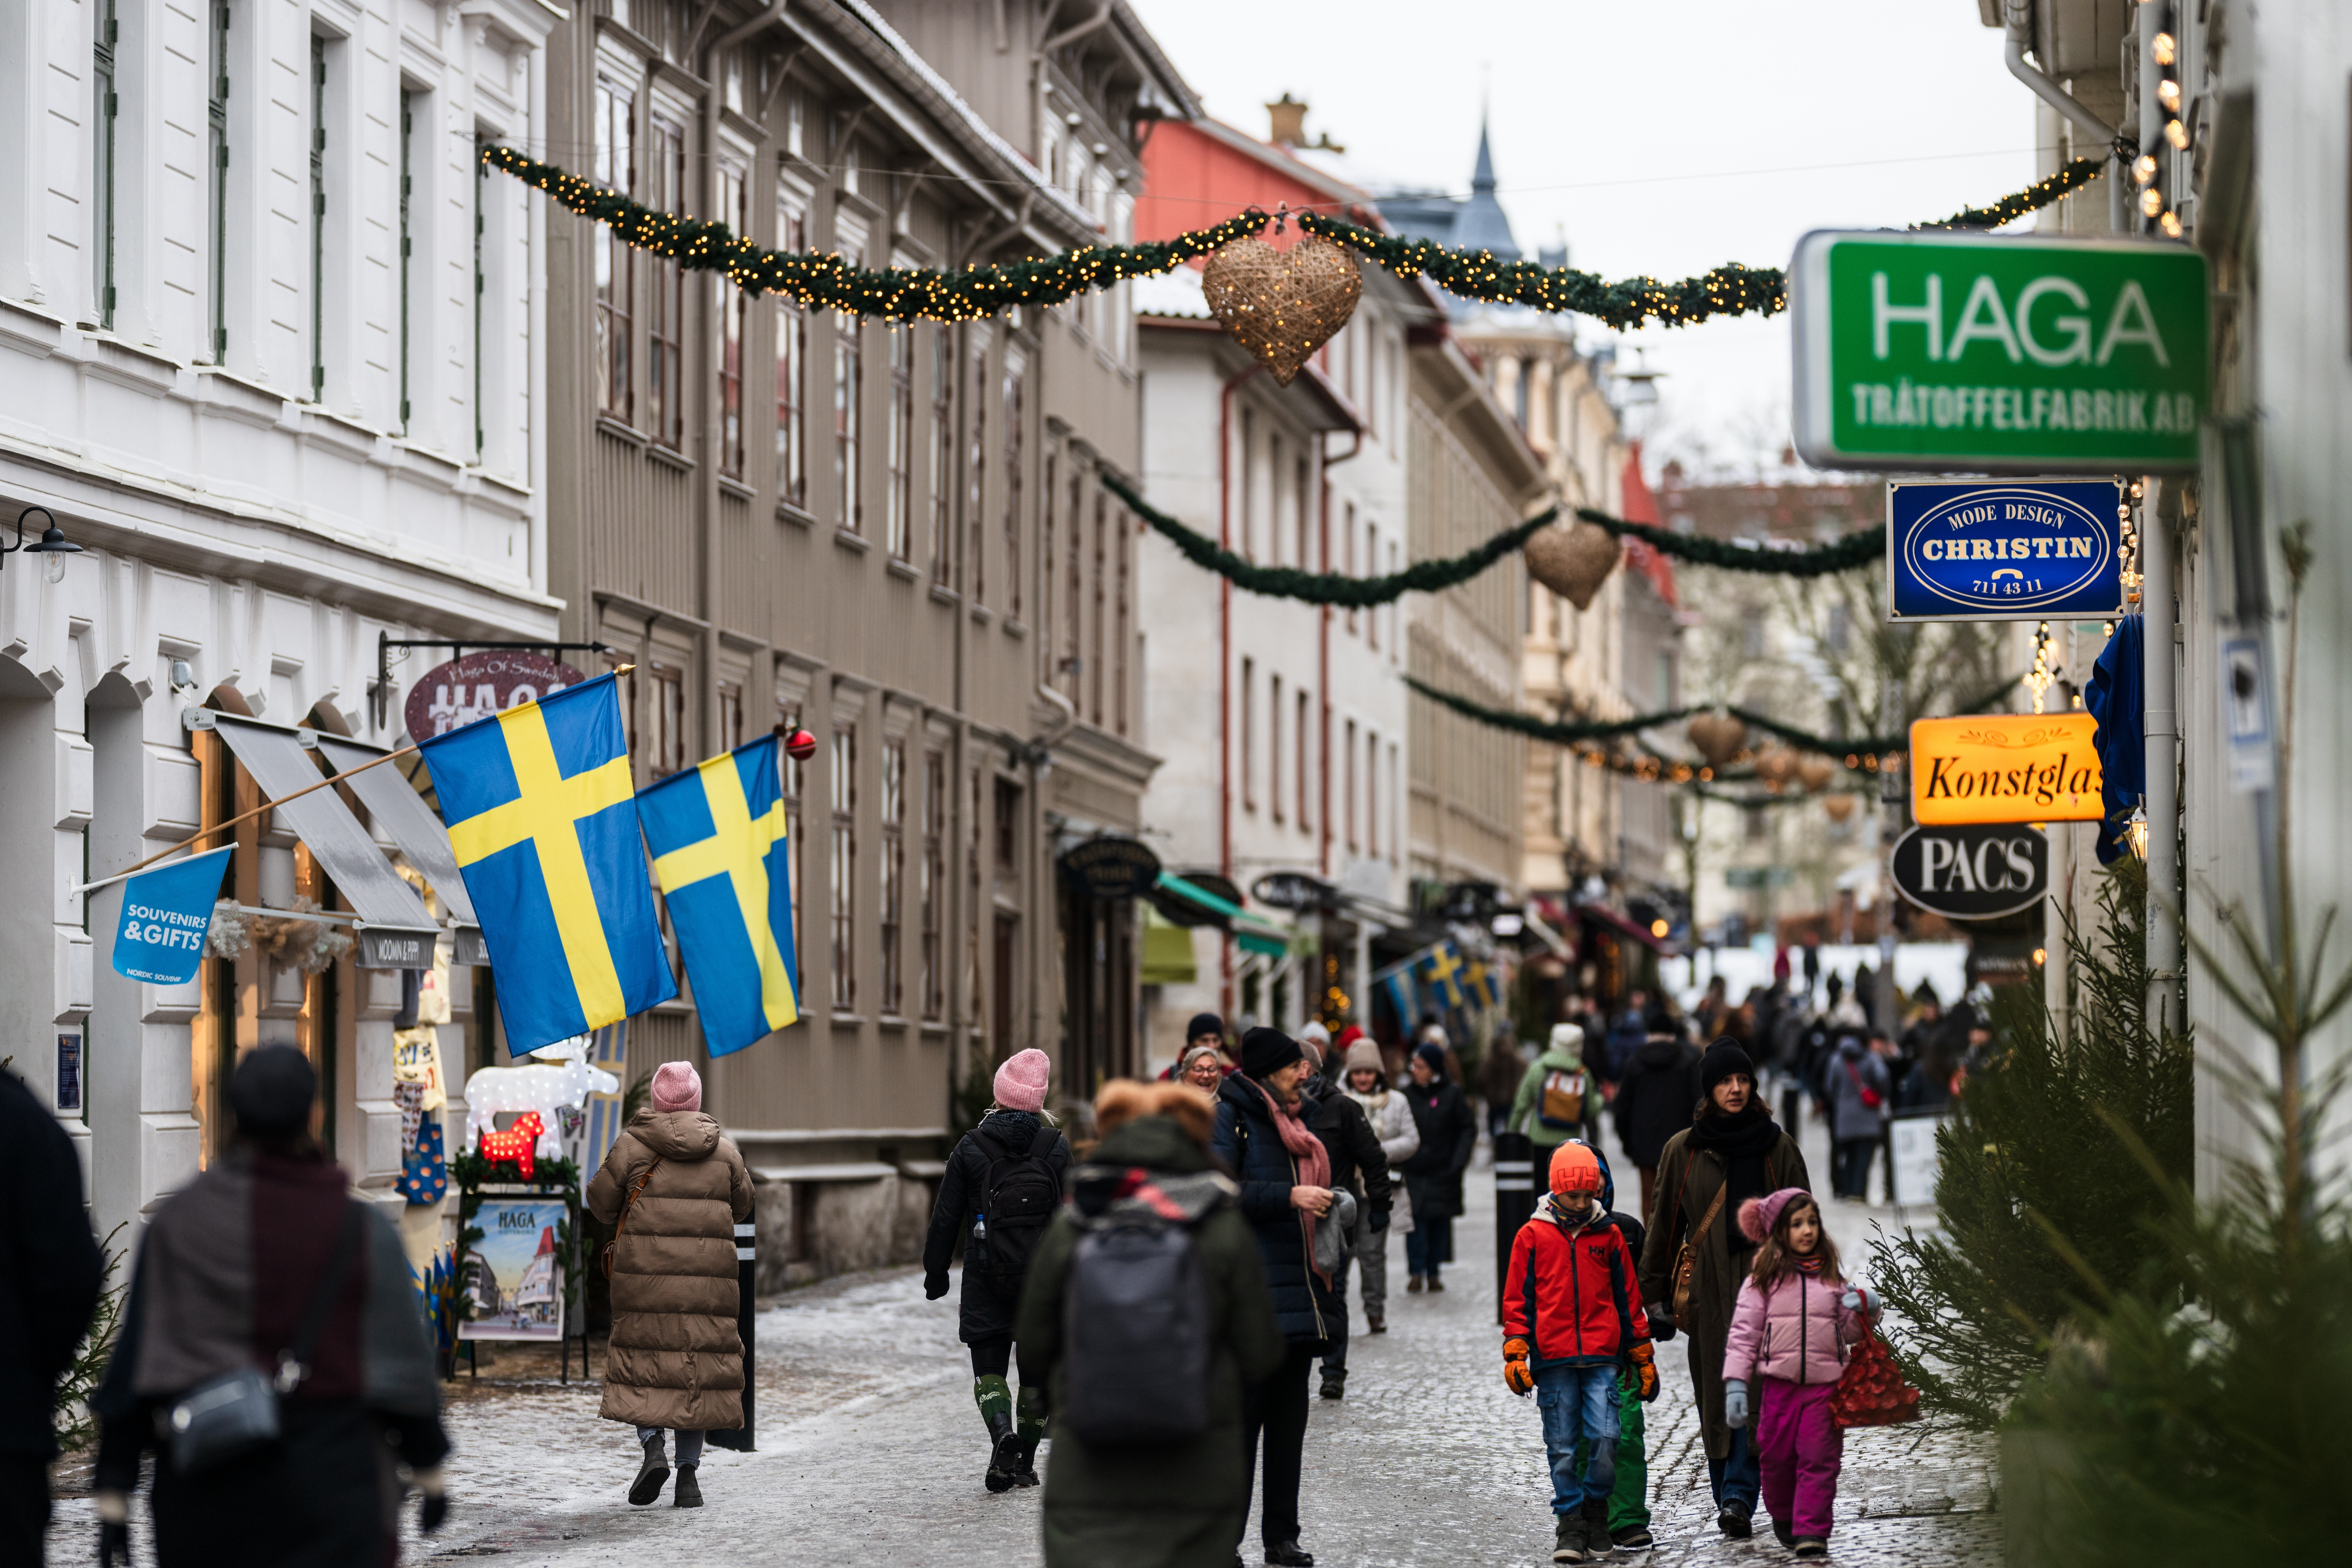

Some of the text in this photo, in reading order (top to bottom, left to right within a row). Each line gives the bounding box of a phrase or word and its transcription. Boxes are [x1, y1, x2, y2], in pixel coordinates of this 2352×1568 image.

[1871, 271, 2170, 368] HAGA
[2153, 390, 2195, 433] AB
[1947, 504, 2066, 532] MODE DESIGN
[1922, 537, 2093, 561] CHRISTIN
[1972, 579, 2043, 595] 711 43 11
[1920, 837, 2035, 893] PACS
[128, 904, 207, 929] SOUVENIRS
[378, 939, 402, 961] MOOMIN
[402, 940, 407, 961] &
[127, 968, 181, 982] NORDIC SOUVENIR
[1557, 1166, 1599, 1192] HH
[499, 1211, 536, 1228] HAGA
[1701, 1216, 1712, 1233] PIERO
[1589, 1245, 1605, 1257] HH
